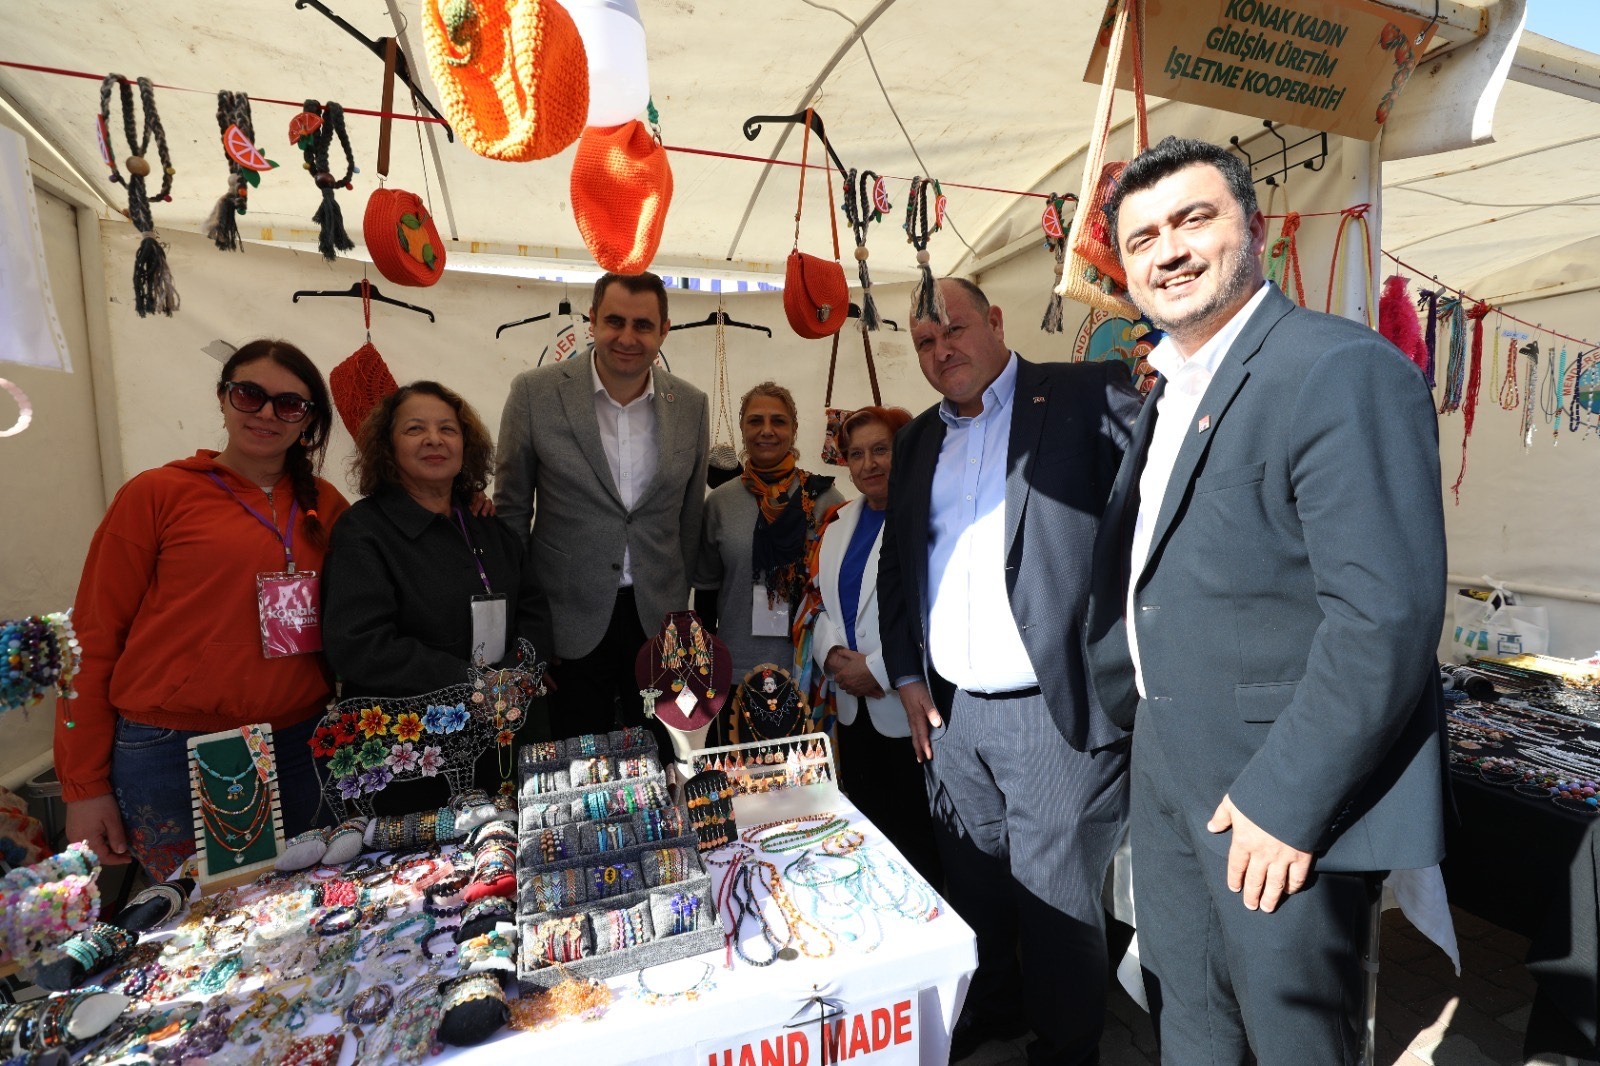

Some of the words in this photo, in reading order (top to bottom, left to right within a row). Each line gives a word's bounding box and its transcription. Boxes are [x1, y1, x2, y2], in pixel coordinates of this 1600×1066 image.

[1206, 24, 1277, 63] GİRİŞİM
[1275, 39, 1339, 78] ÜRETİM
[1224, 0, 1297, 33] KONAK
[1291, 13, 1348, 48] KADIN
[1163, 45, 1244, 88] İŞLETME
[1240, 69, 1347, 111] KOOPERATİFİ
[823, 999, 912, 1066] MADE
